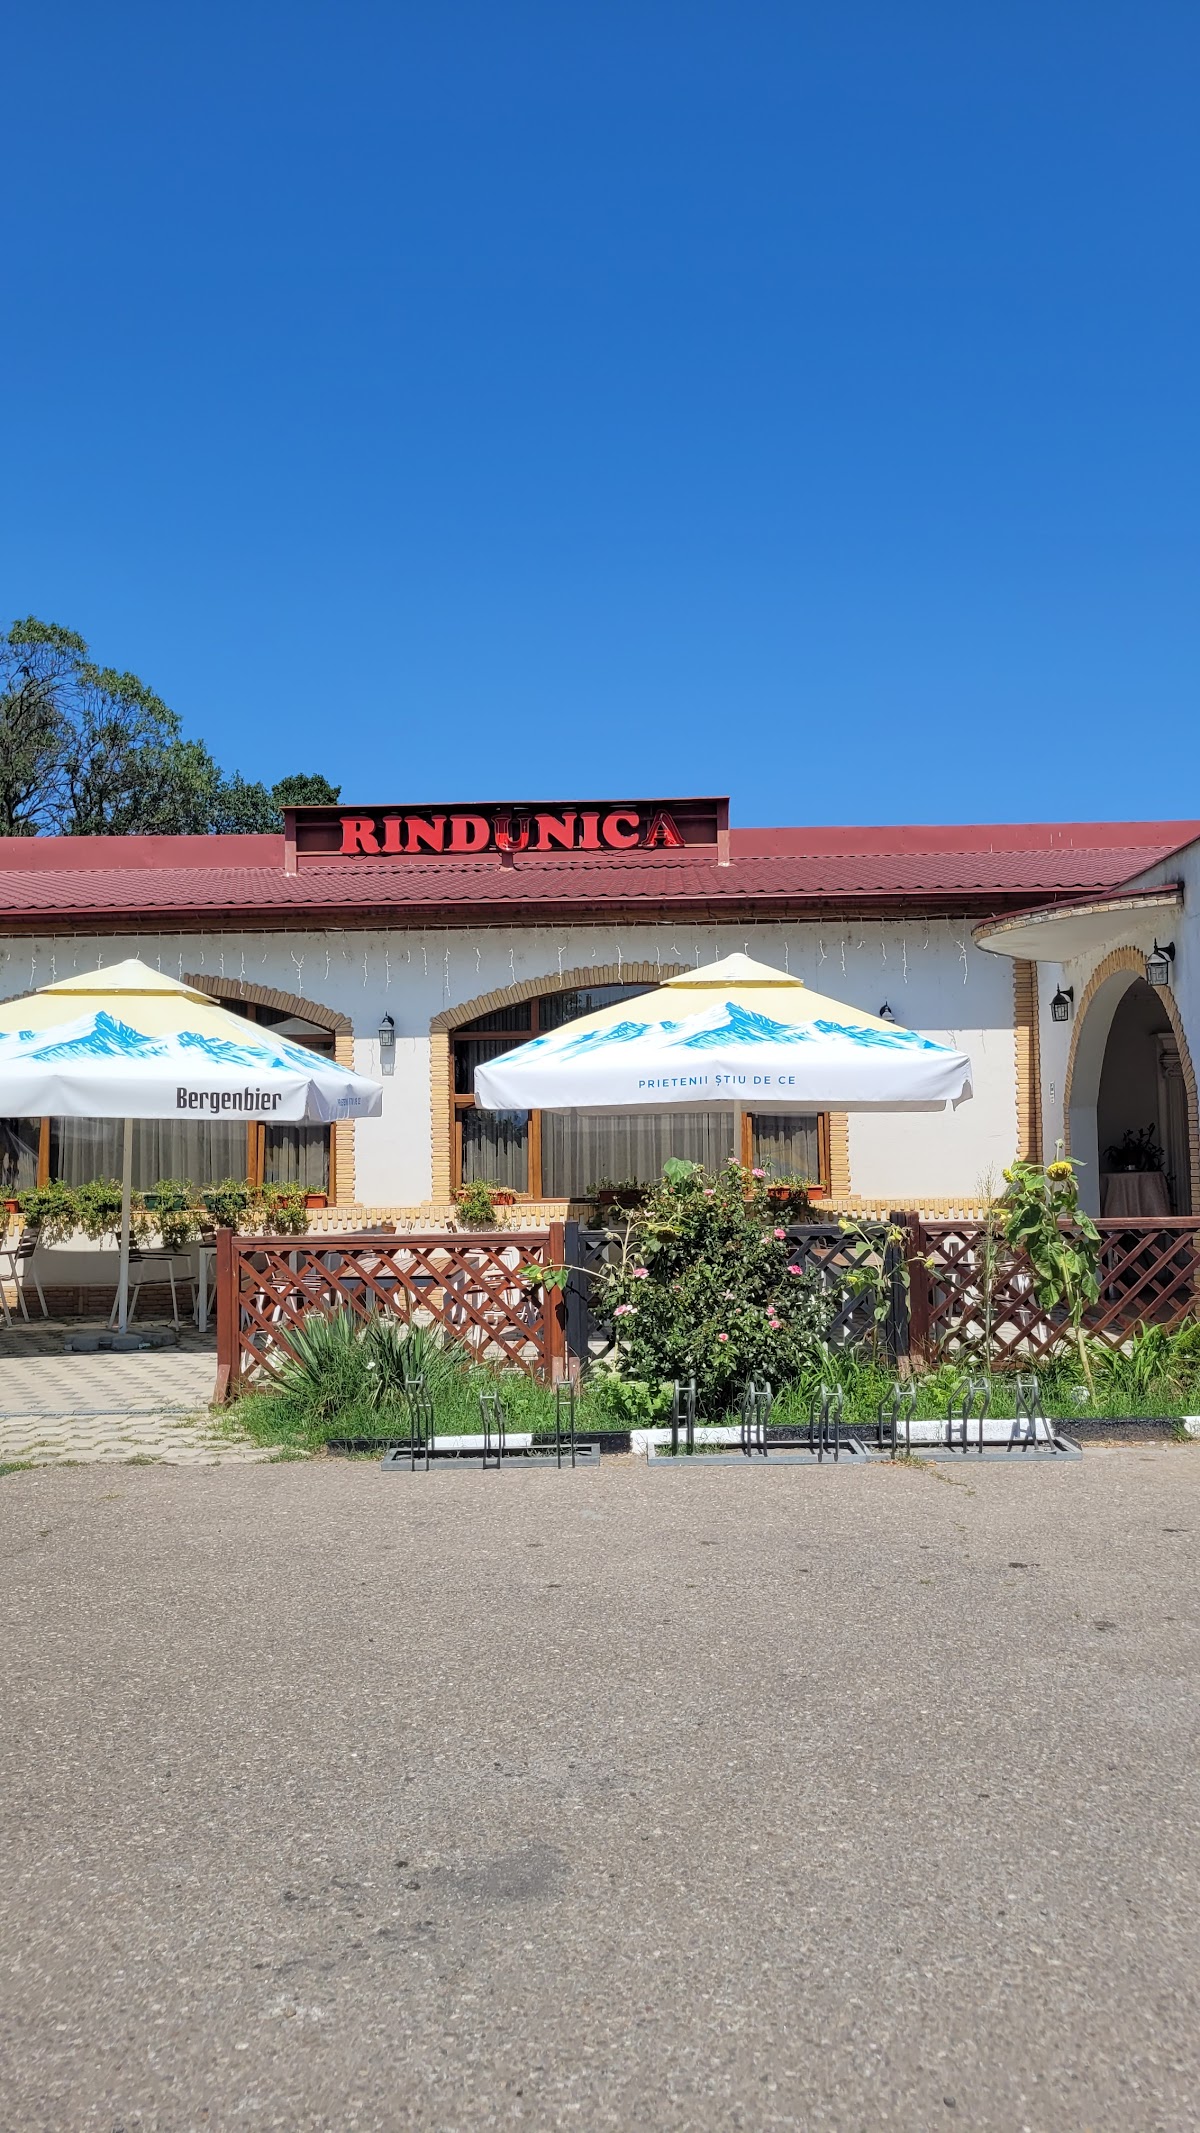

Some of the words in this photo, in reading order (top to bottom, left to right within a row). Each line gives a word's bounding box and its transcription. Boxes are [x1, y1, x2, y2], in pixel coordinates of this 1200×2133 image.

[339, 809, 686, 854] RINDUNICA
[638, 1076, 708, 1088] PRIETENII
[715, 1075, 746, 1086] ȘTIU
[753, 1076, 771, 1085] DE
[778, 1076, 796, 1085] CE
[176, 1087, 282, 1114] Bergenbier
